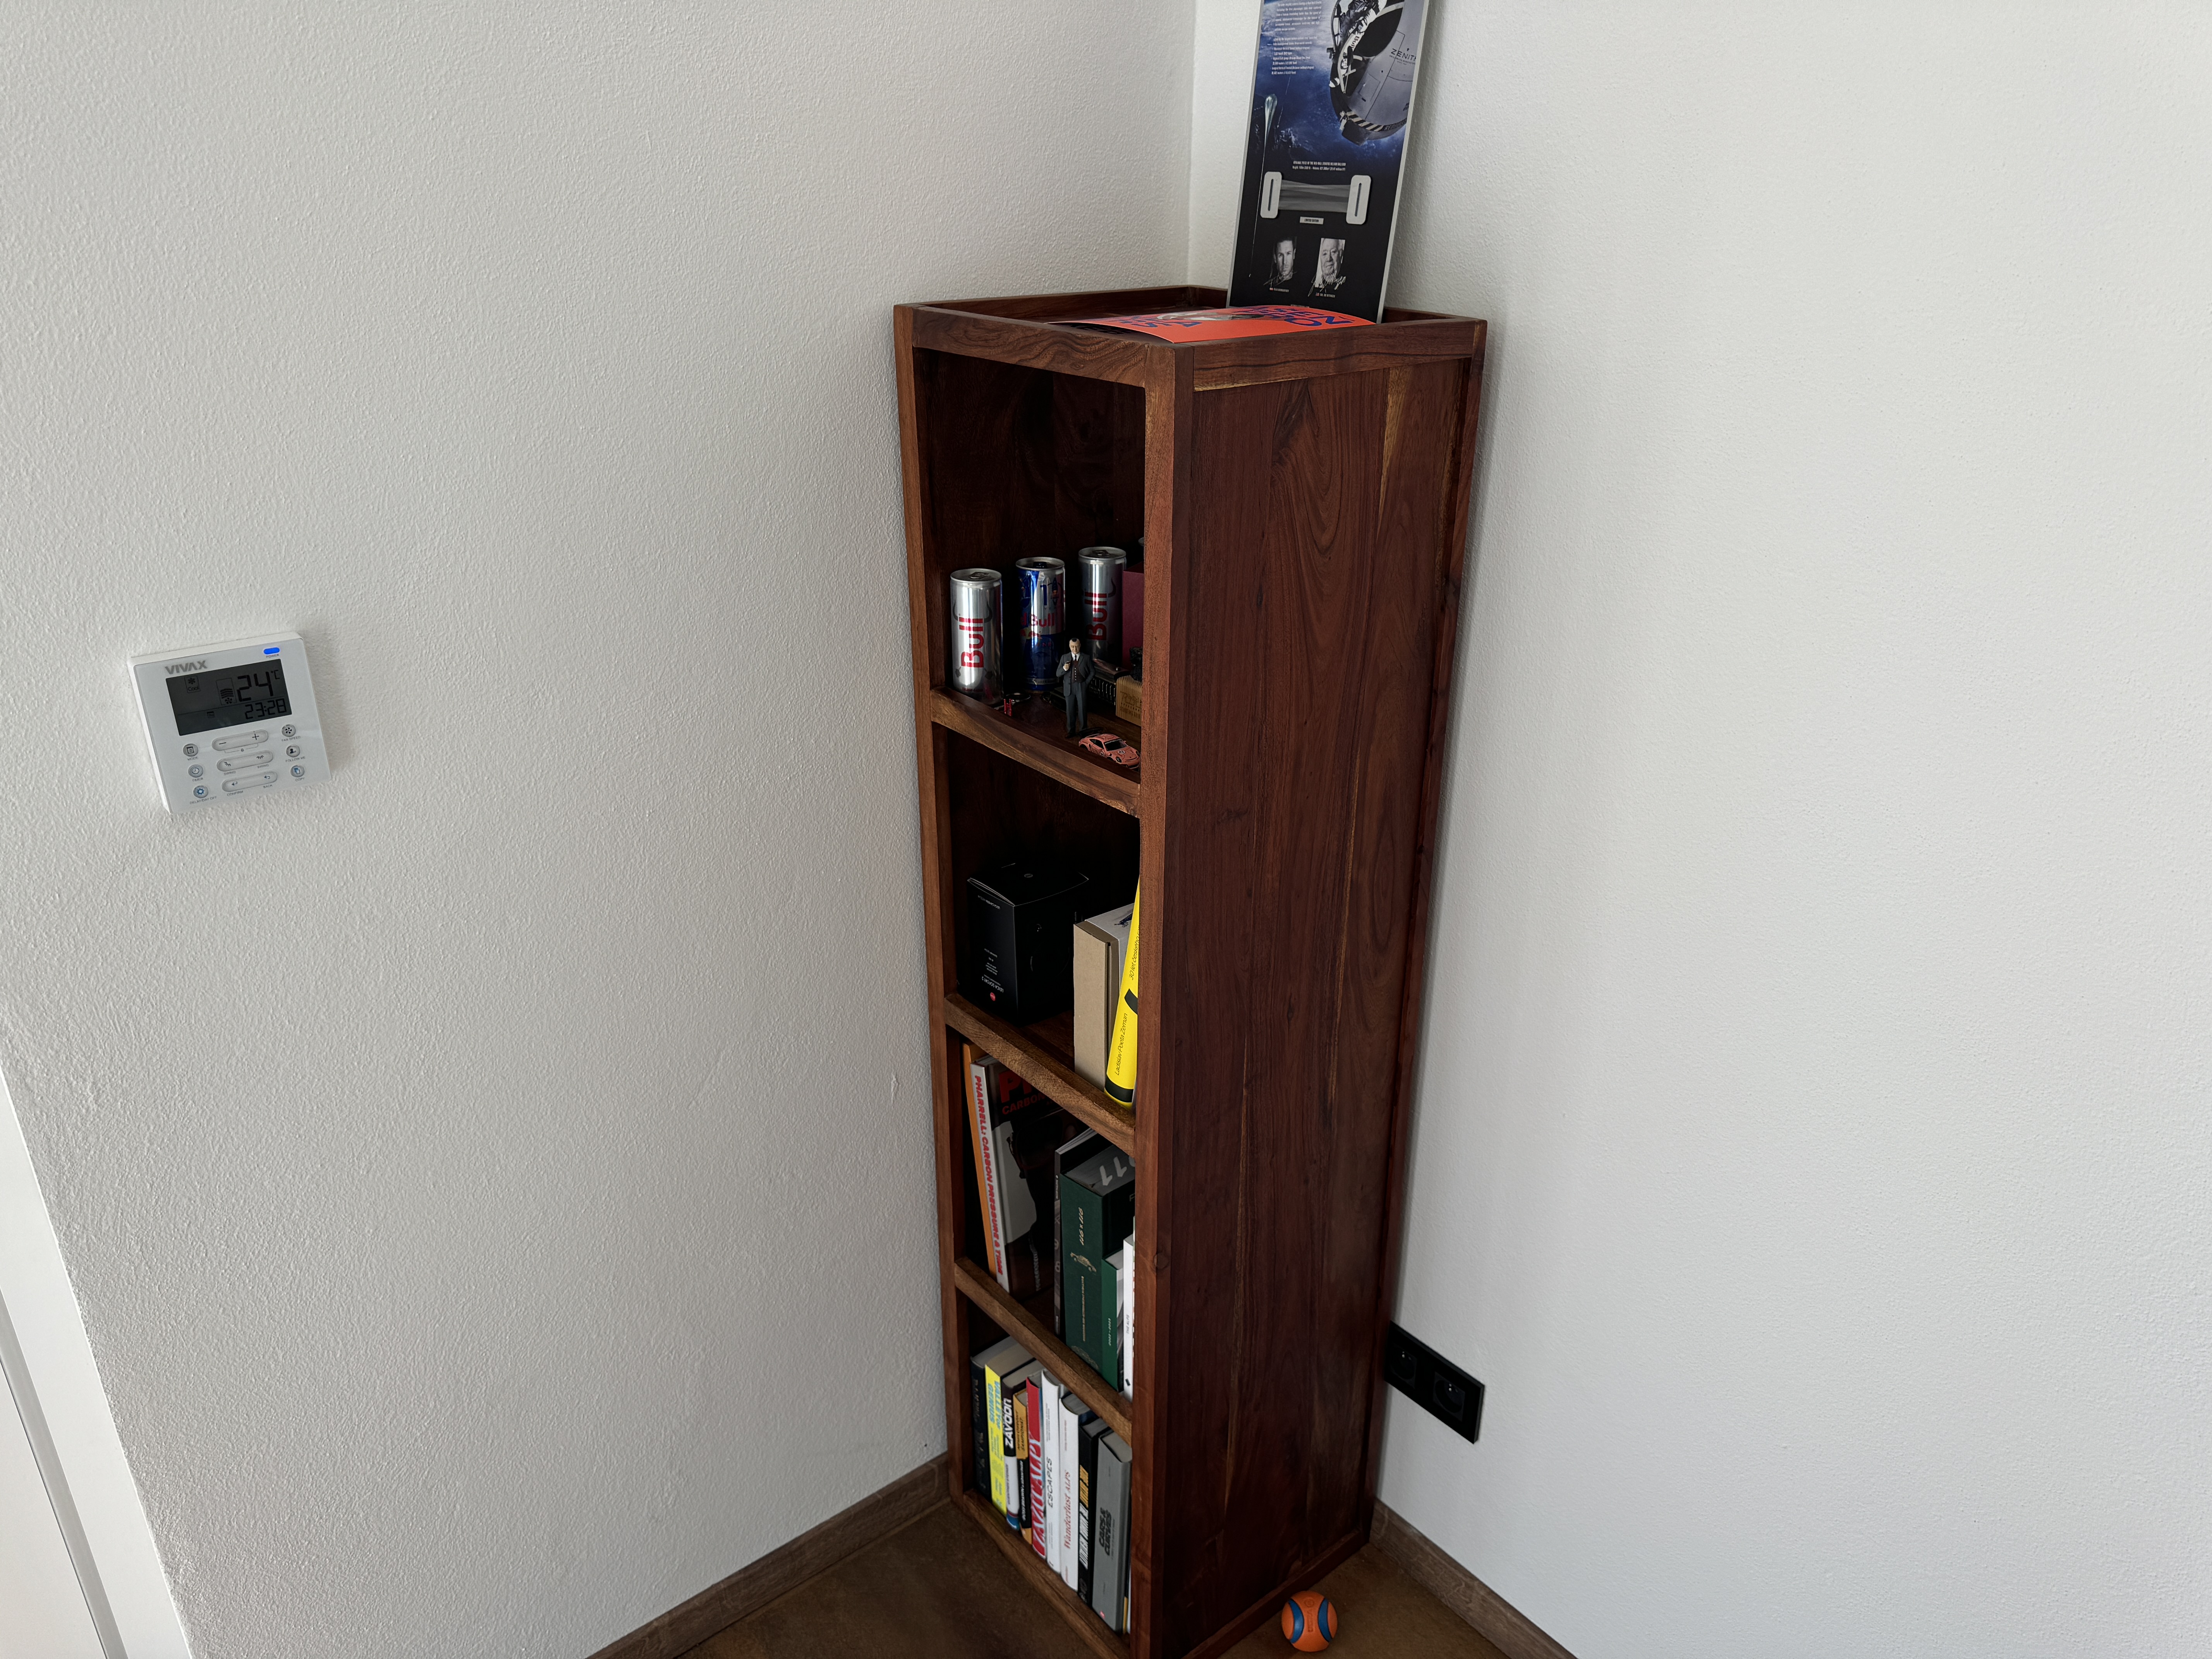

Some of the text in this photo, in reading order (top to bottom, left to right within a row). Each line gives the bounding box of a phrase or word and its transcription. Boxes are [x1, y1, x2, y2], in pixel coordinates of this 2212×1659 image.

[1084, 592, 1108, 640] Bull
[959, 618, 985, 668] Bull
[165, 660, 208, 675] VIVAX
[245, 698, 287, 719] 23:28
[988, 1183, 999, 1239] PRESSURE
